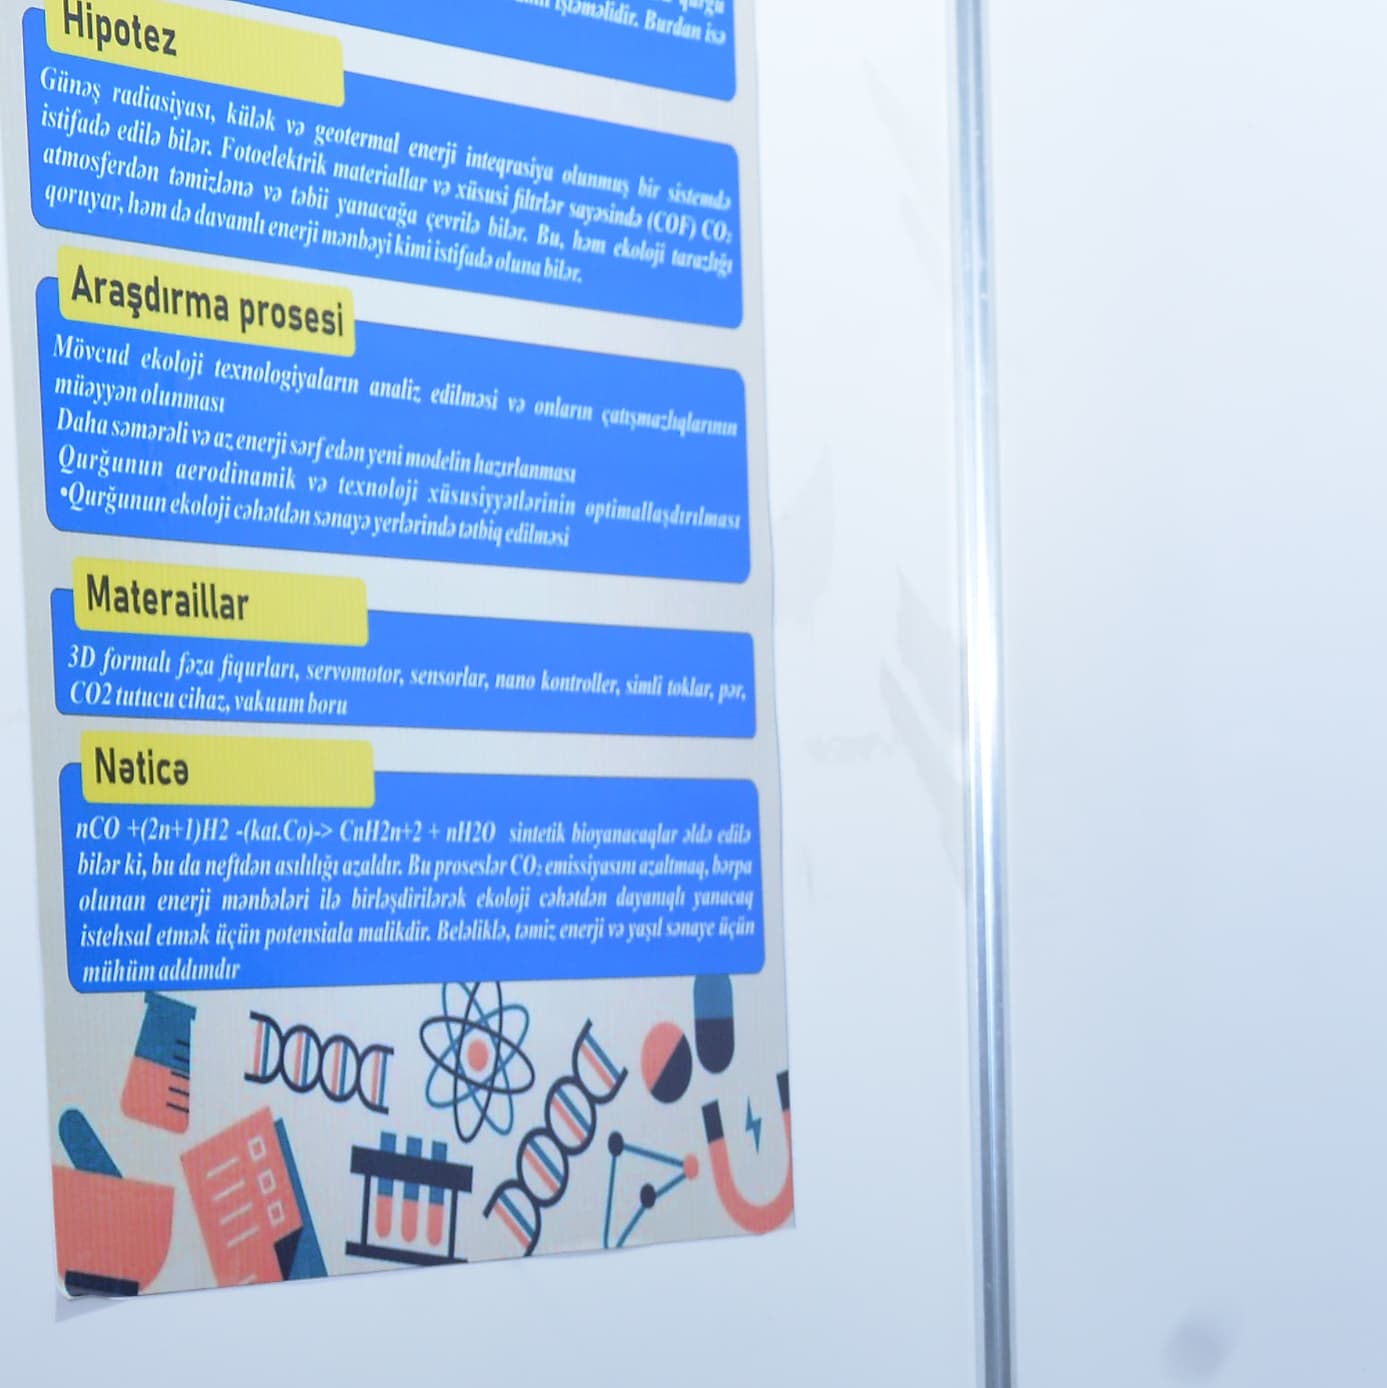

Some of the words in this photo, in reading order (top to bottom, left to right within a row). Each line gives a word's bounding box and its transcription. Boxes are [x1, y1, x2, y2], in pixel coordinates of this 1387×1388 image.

[63, 0, 177, 56] Hipotez
[287, 119, 304, 137] və
[314, 125, 399, 154] geotermal
[72, 265, 228, 322] Araşdırma
[240, 298, 342, 337] prosesi
[87, 573, 248, 621] Materaillar
[68, 645, 95, 668] 3D
[96, 747, 188, 786] Nəticə
[76, 816, 120, 840] nCO
